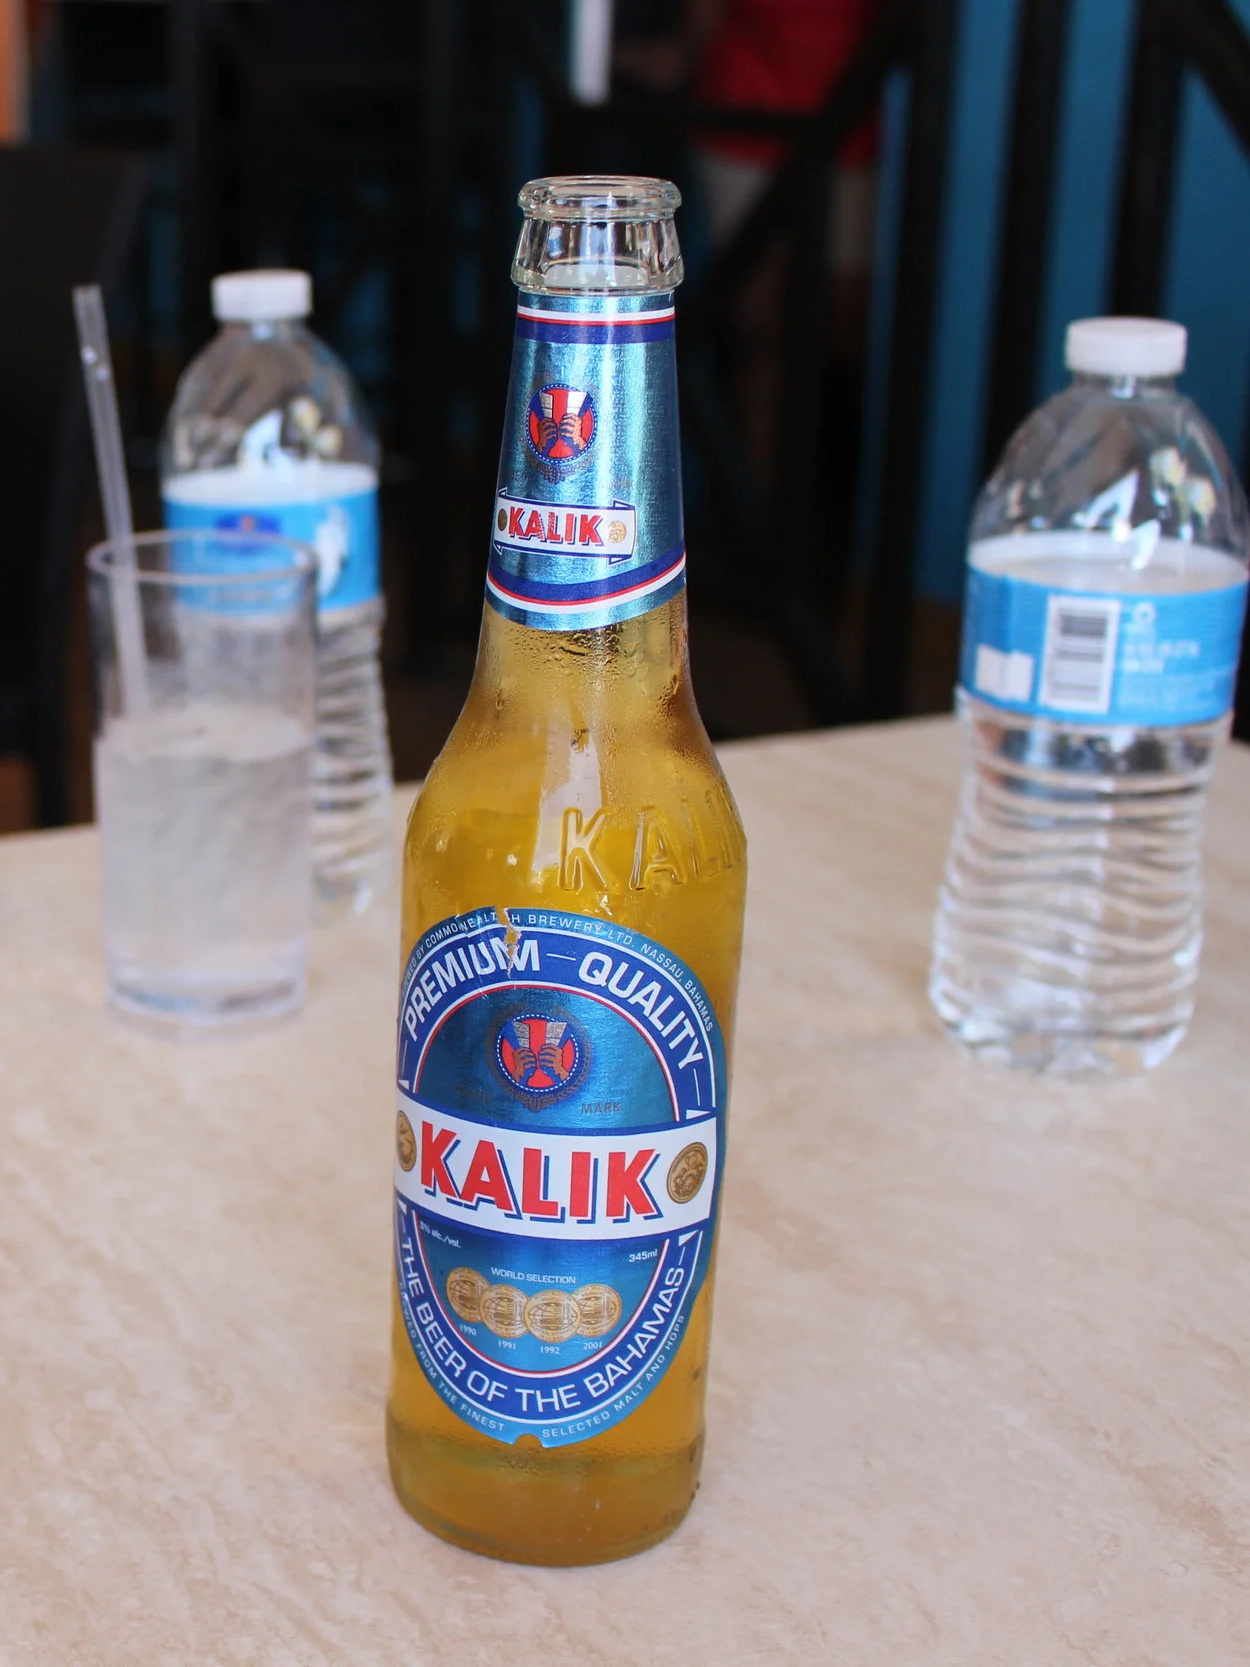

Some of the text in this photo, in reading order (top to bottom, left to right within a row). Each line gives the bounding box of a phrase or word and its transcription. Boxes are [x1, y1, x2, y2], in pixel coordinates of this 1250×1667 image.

[508, 506, 607, 547] KALIK
[405, 936, 704, 1070] PREMIUM QUALITY
[416, 944, 425, 960] BY
[528, 914, 603, 934] BREWERY
[608, 929, 635, 947] LTD.
[640, 943, 684, 982] NASSAU,
[684, 979, 714, 1032] BAHAMAS
[581, 1102, 622, 1114] MARK
[421, 1120, 664, 1224] KALIK
[491, 1267, 577, 1284] WORLD SELECTION
[628, 1248, 658, 1263] 345ml
[401, 1237, 685, 1413] THE BEER OF THE BAHAMAS
[459, 1324, 602, 1355] 1990 1991 1992 2001
[415, 1343, 438, 1379] FROM
[438, 1381, 458, 1404] THE
[460, 1403, 506, 1432] FINEST
[542, 1411, 610, 1438] SELECTED
[613, 1382, 644, 1412] MALT
[645, 1354, 666, 1382] AND
[666, 1315, 685, 1351] HOPS
